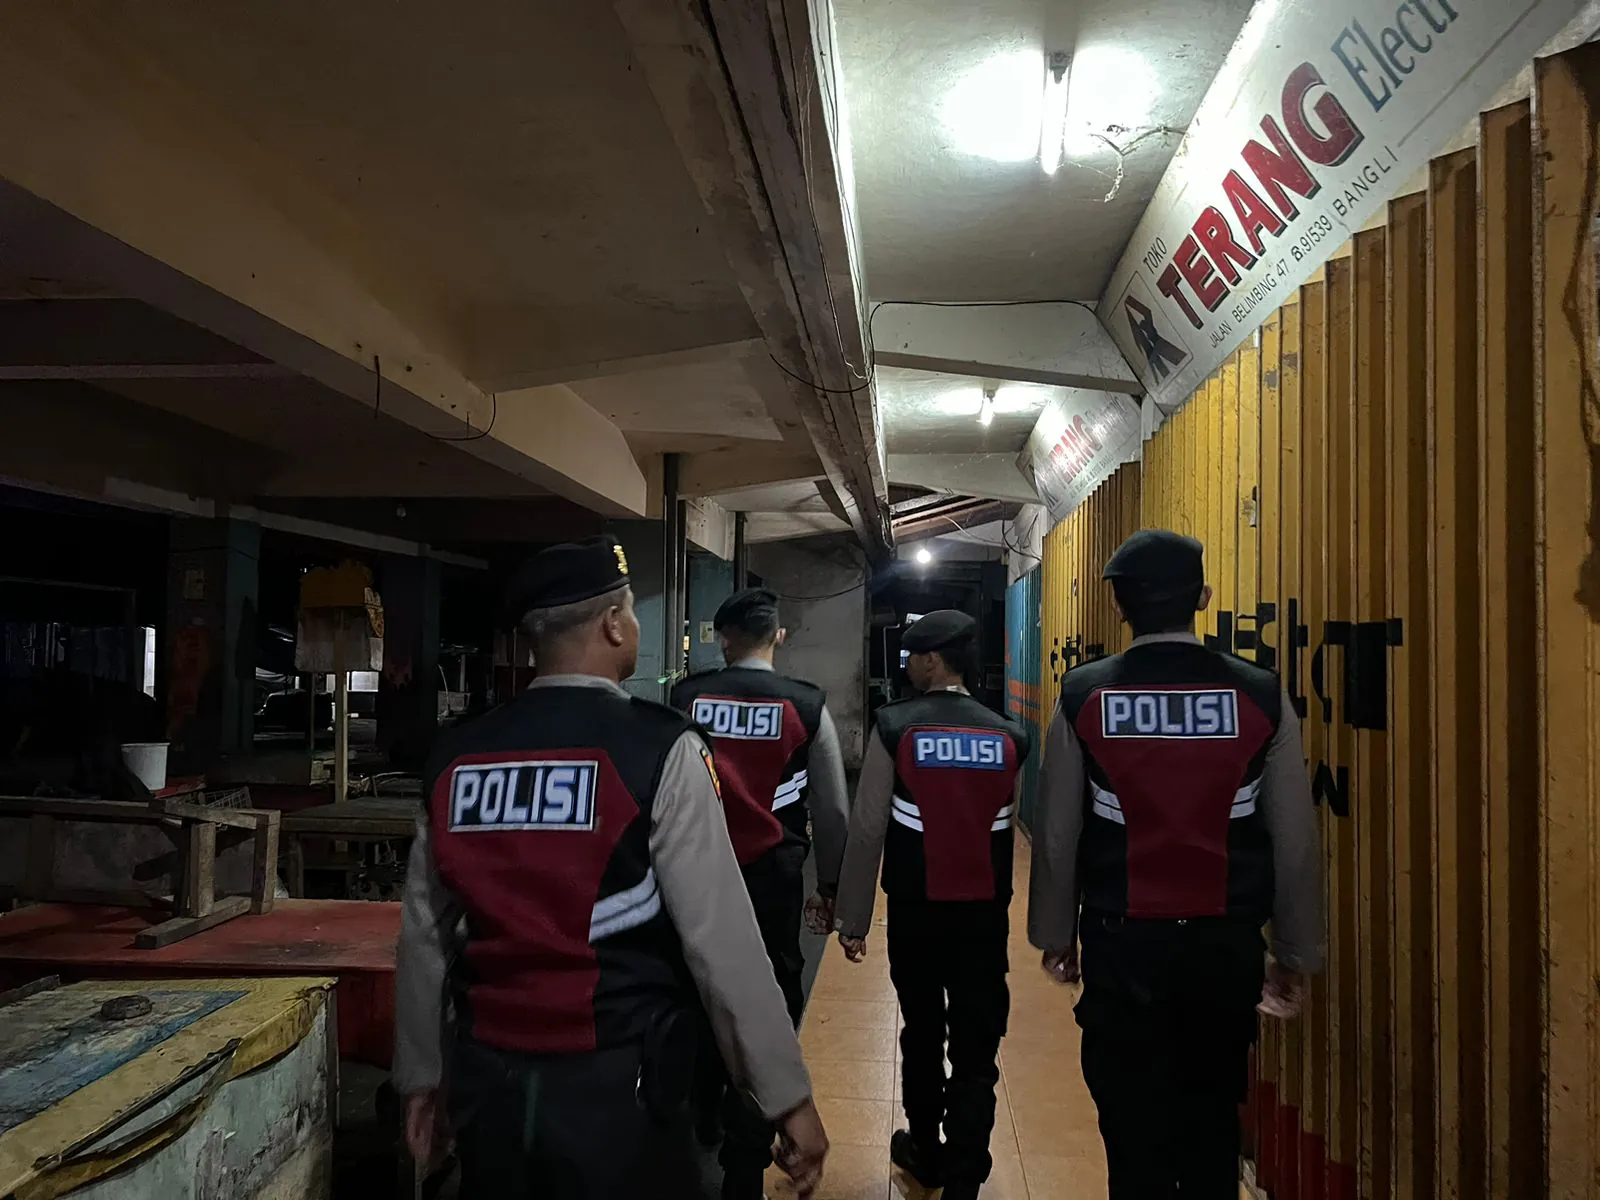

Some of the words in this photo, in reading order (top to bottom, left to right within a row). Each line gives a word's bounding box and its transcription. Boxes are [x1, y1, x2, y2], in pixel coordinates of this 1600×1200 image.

[1156, 62, 1364, 330] TERANG
[1143, 237, 1167, 274] TOKO
[1210, 321, 1232, 348] JALAN
[1231, 273, 1277, 323] BELIMBING
[1277, 259, 1290, 277] 47
[1332, 145, 1398, 217] BANGLI
[695, 703, 780, 736] POLISI
[1106, 695, 1235, 735] POLISI
[916, 738, 1004, 764] POLISI
[453, 767, 590, 825] POLISI
